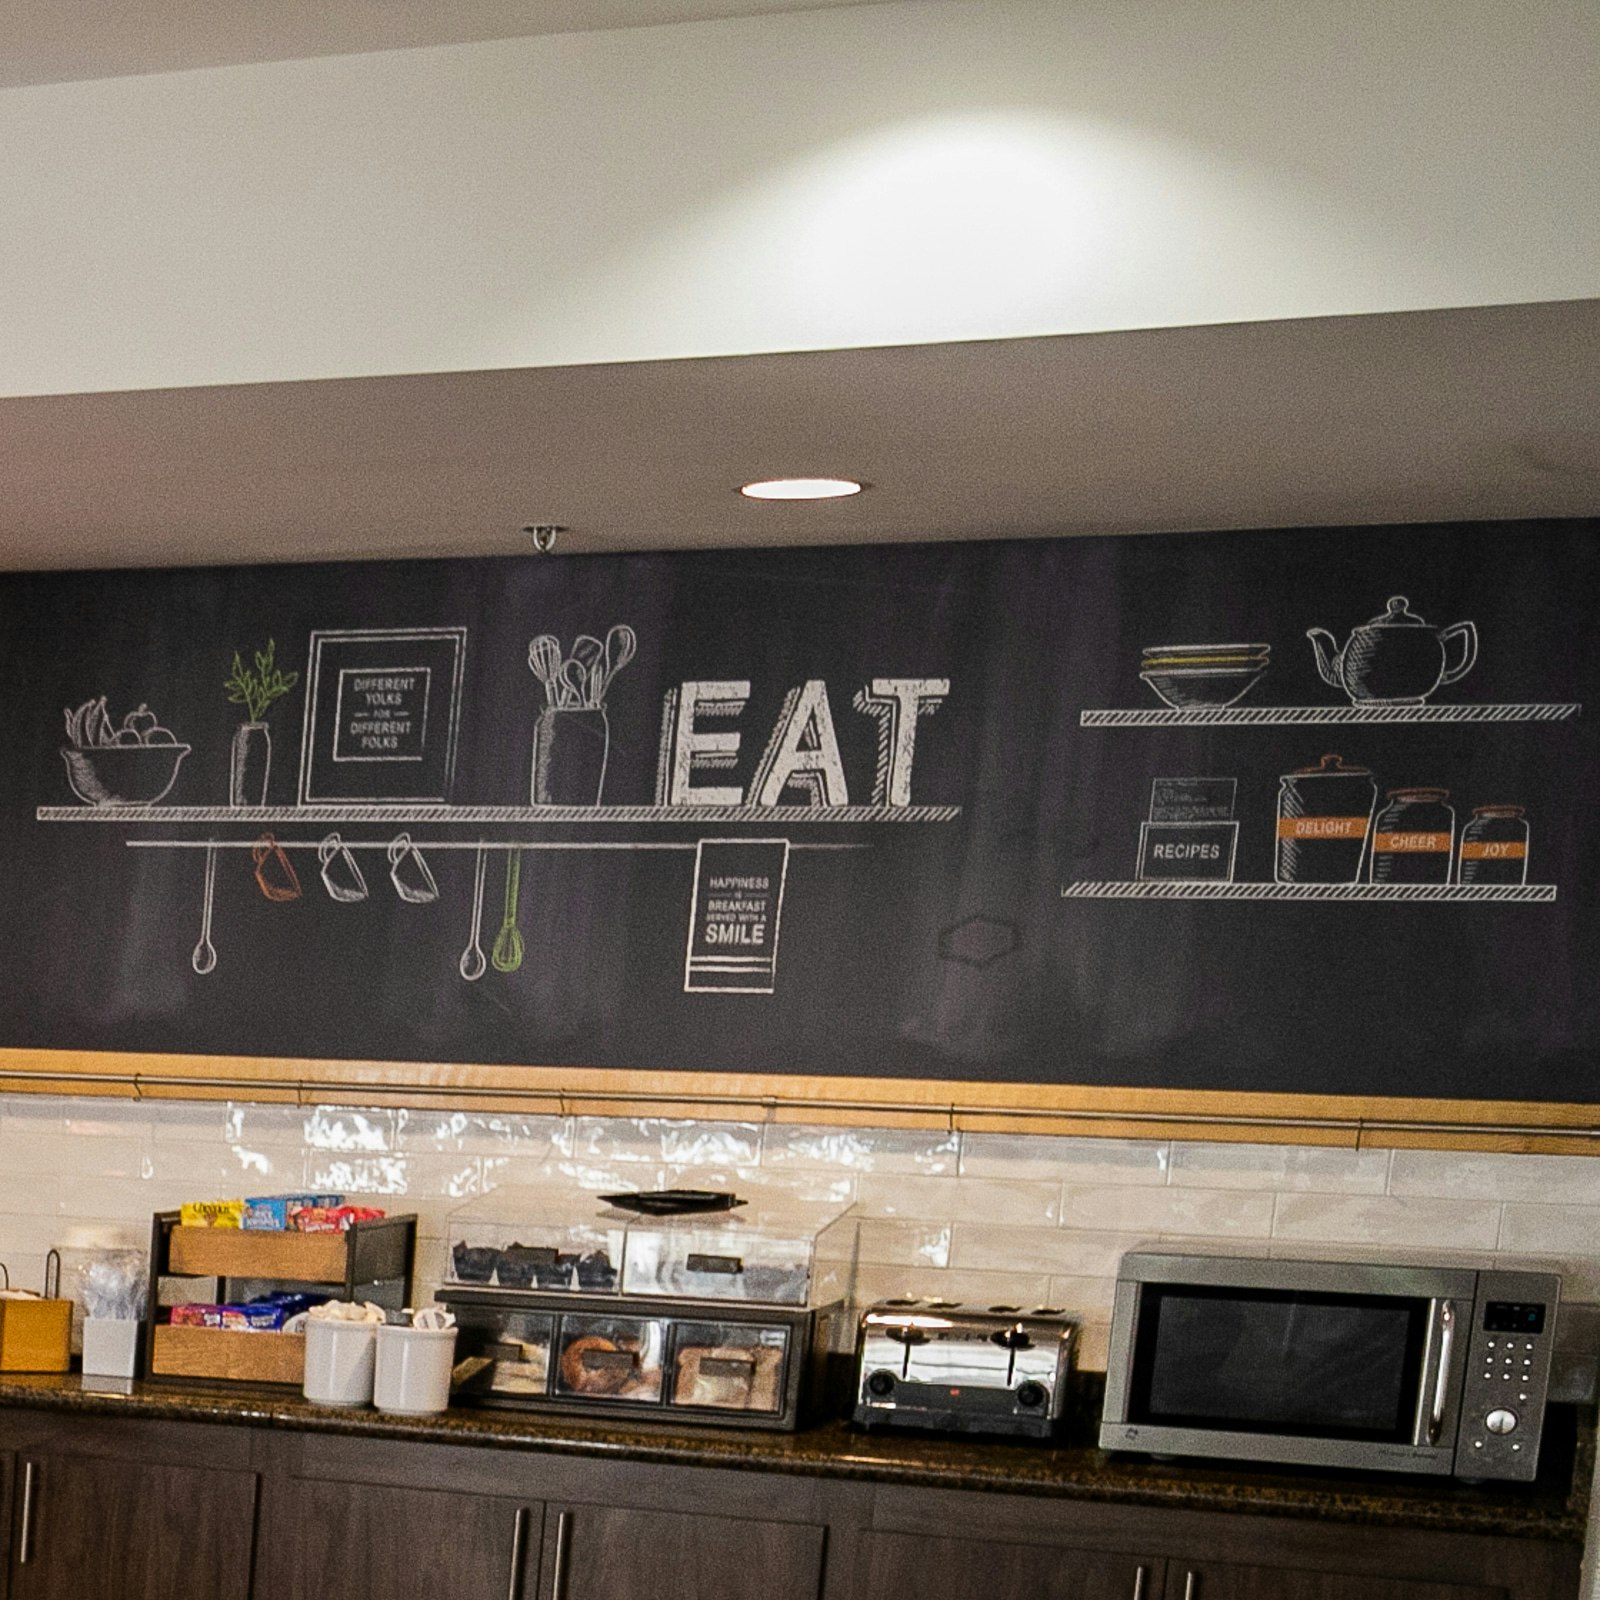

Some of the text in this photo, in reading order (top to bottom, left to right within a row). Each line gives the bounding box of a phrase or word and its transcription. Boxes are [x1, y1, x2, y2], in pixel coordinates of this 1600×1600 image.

[353, 677, 415, 692] DIFFERENT
[365, 692, 402, 706] YOLKS
[350, 721, 411, 735] DIFFERENT
[361, 736, 398, 749] FOLKS
[657, 678, 951, 807] EAT
[1296, 822, 1352, 835] DELIGHT
[1390, 835, 1437, 849] CHEER
[1153, 843, 1220, 859] RECIPES
[1481, 843, 1509, 857] JOY
[709, 877, 769, 889] HAPPINESS
[708, 900, 766, 912] BREAKFAST
[705, 923, 765, 944] SMILE
